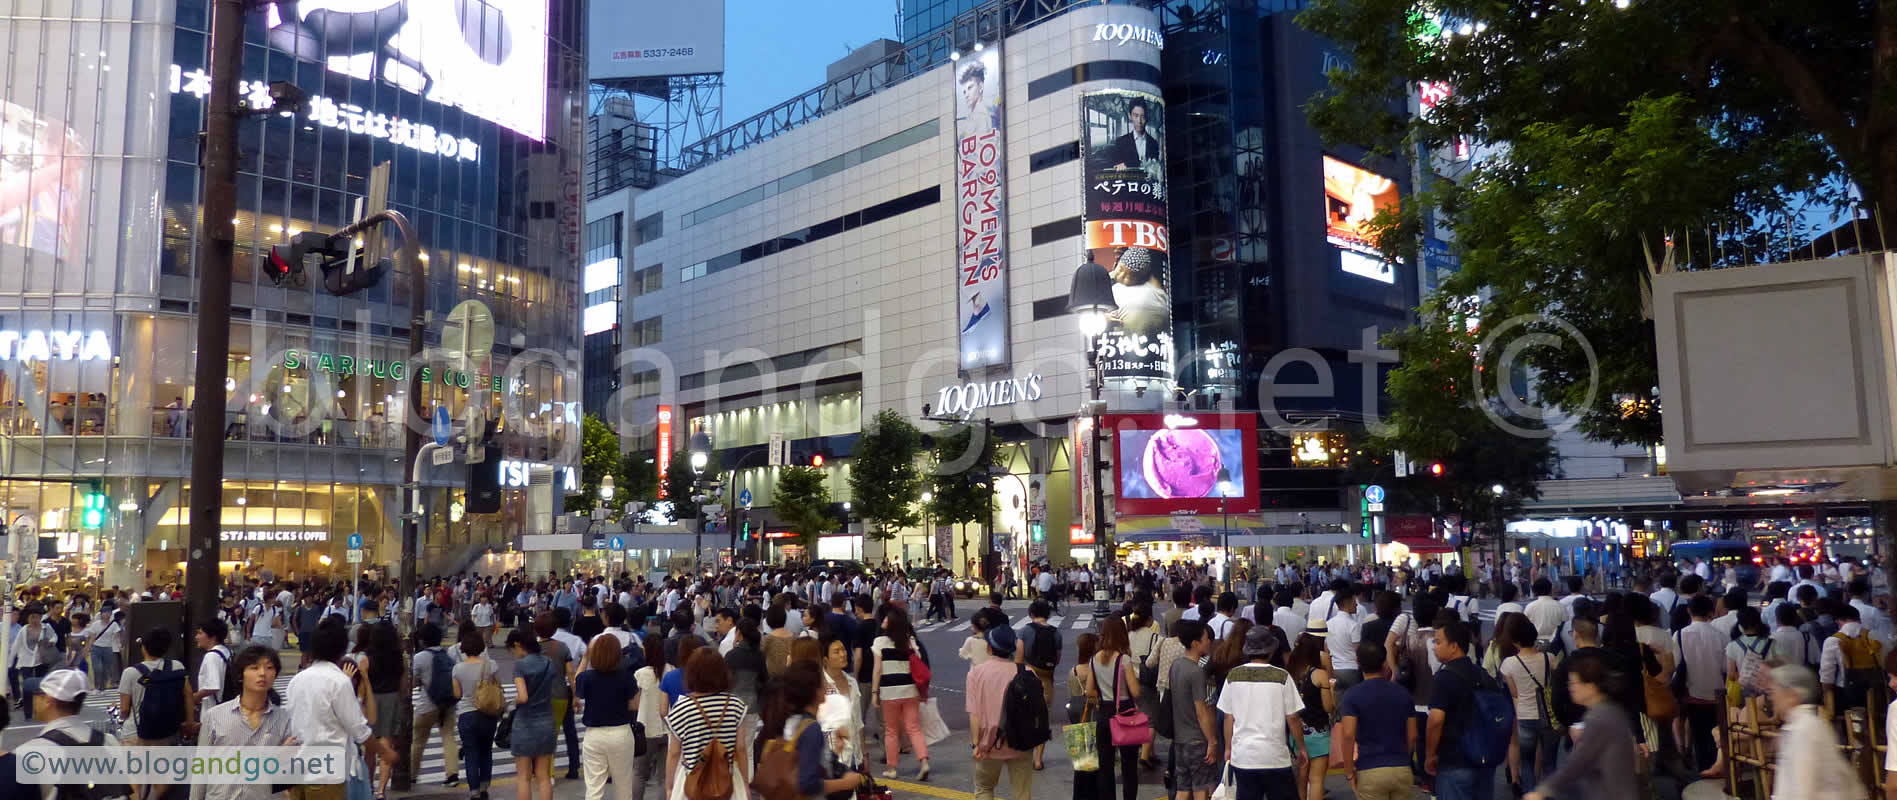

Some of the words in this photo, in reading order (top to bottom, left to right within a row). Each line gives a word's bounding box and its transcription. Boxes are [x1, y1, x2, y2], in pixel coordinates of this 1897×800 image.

[961, 135, 980, 287] BARGAIN
[1103, 220, 1167, 251] TBS
[220, 531, 297, 541] STARBUCKS
